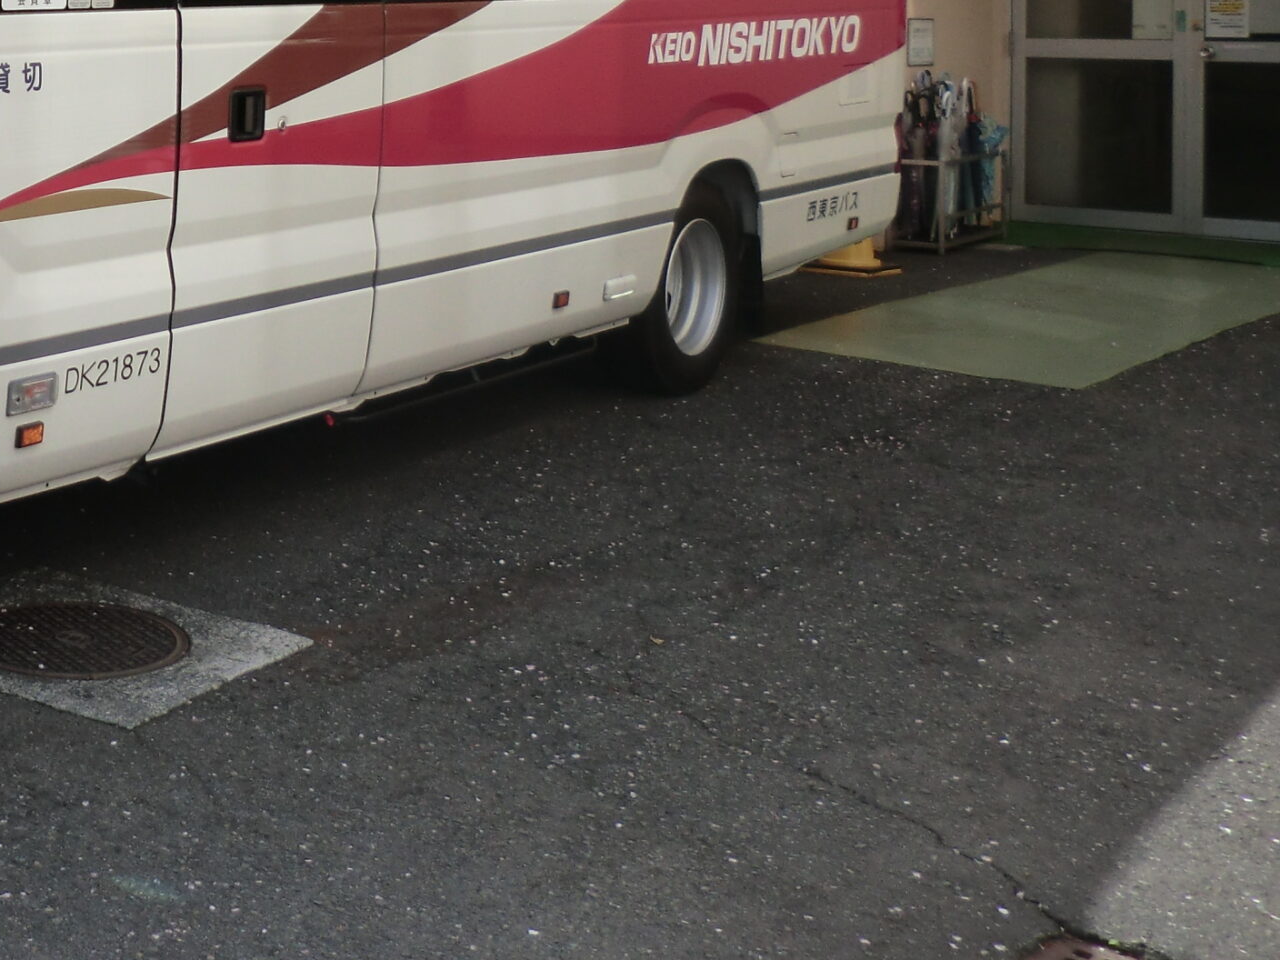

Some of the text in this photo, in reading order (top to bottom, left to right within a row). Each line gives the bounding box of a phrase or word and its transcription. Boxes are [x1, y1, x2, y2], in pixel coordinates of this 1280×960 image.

[648, 31, 696, 65] KEIO
[697, 15, 861, 67] NISHITOKYO
[807, 191, 858, 222] 西東京バス
[64, 347, 161, 394] DK21873
